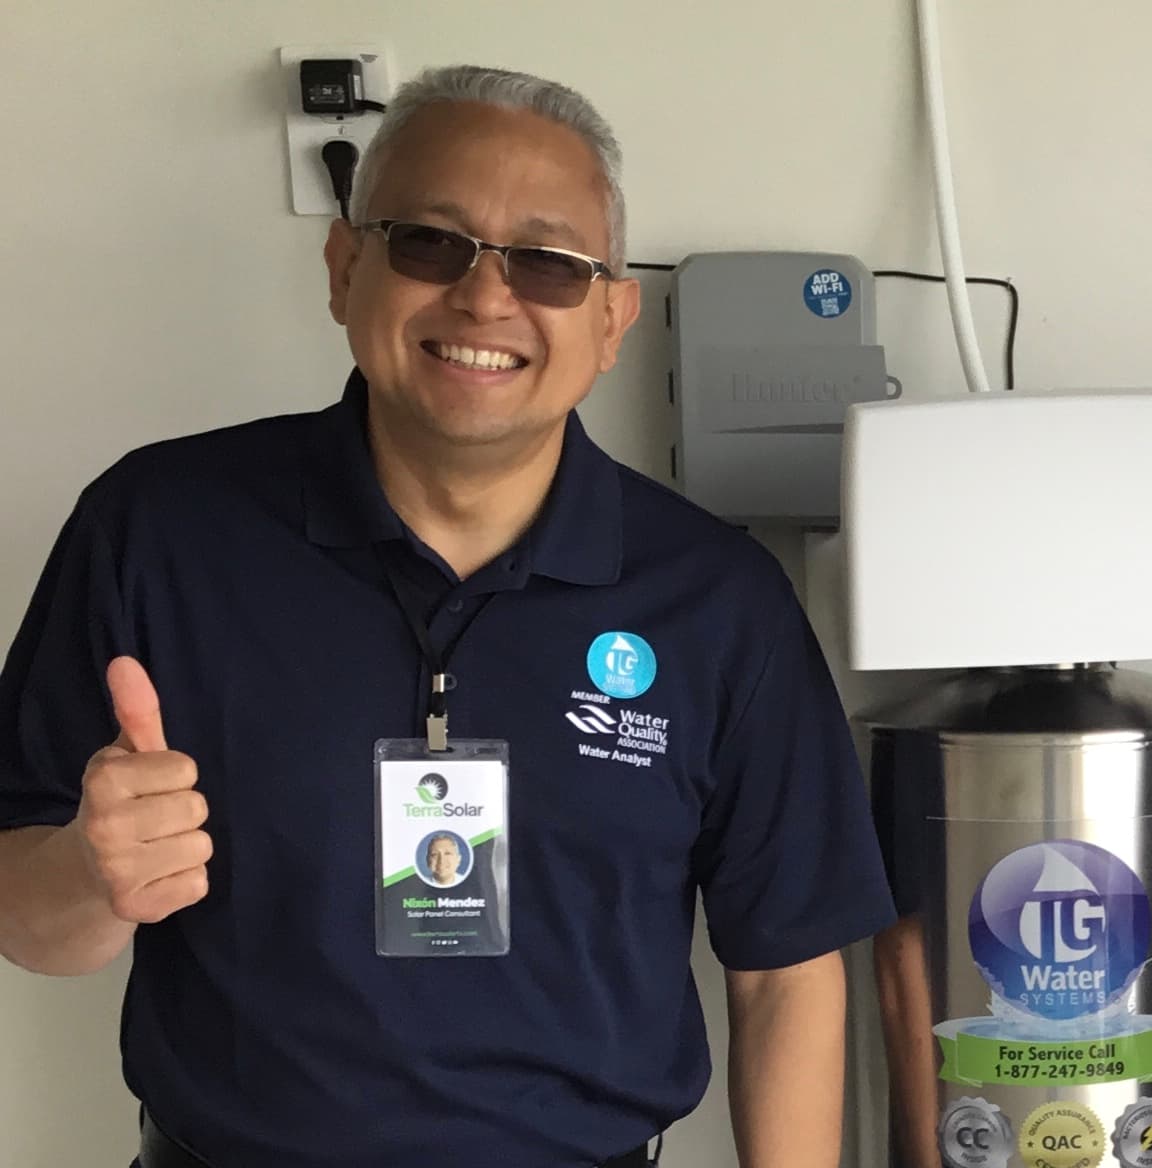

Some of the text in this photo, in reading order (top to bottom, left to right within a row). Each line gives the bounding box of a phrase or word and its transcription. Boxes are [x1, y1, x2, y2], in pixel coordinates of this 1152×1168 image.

[812, 272, 839, 285] ADD
[811, 282, 843, 296] WI-FI
[570, 690, 611, 704] MEMBER
[620, 709, 669, 730] Water
[618, 722, 667, 745] Quality
[617, 737, 666, 754] ASSOCIATION
[579, 743, 652, 767] Water Analyst
[403, 802, 484, 818] TerraSolar
[437, 896, 486, 908] Mendez
[1020, 964, 1105, 991] Water
[1019, 992, 1106, 1006] SYSTEMS
[999, 1043, 1116, 1061] For Service Call
[994, 1060, 1125, 1079] 1-877-247-9849
[1028, 1110, 1054, 1137] QUALITY
[1057, 1109, 1096, 1135] ASSURANCE
[956, 1126, 989, 1150] CC
[1042, 1134, 1083, 1152] QAC
